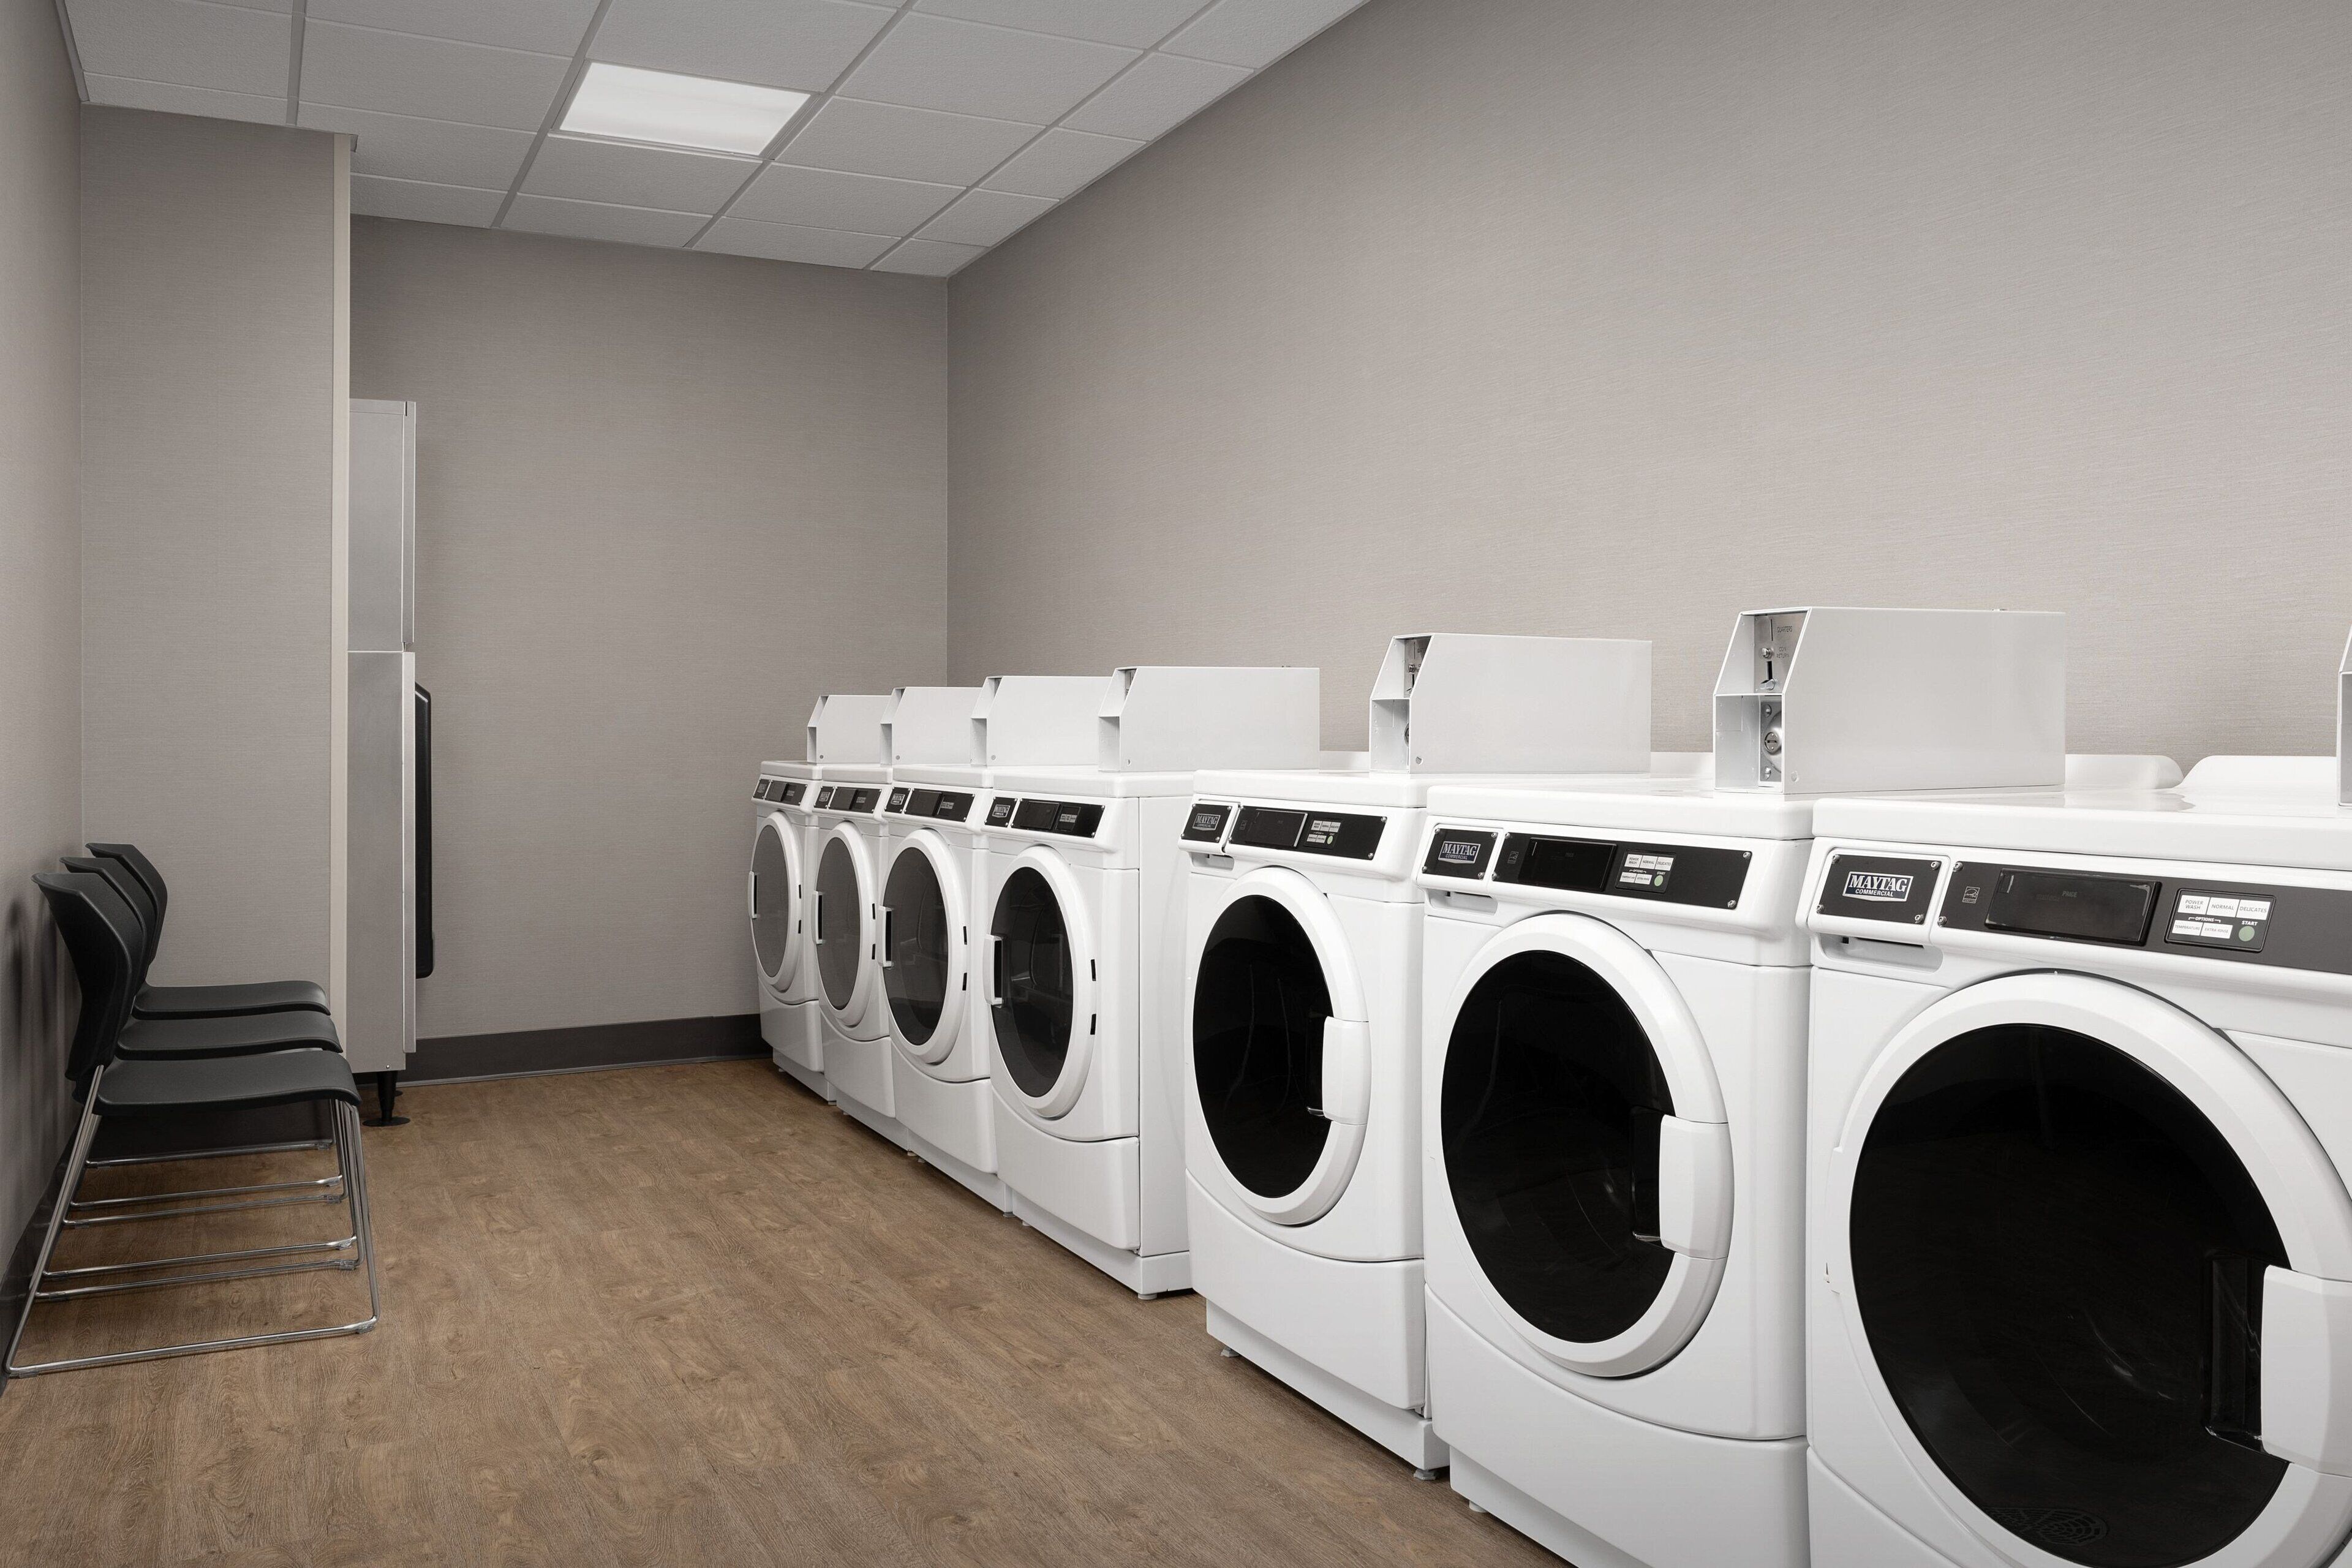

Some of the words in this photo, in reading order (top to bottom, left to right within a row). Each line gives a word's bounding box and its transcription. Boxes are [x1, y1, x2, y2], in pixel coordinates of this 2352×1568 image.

[1442, 843, 1477, 856] MAYTAG
[1849, 875, 1908, 892] MAYTAG
[1855, 888, 1894, 897] COMMERCIAL
